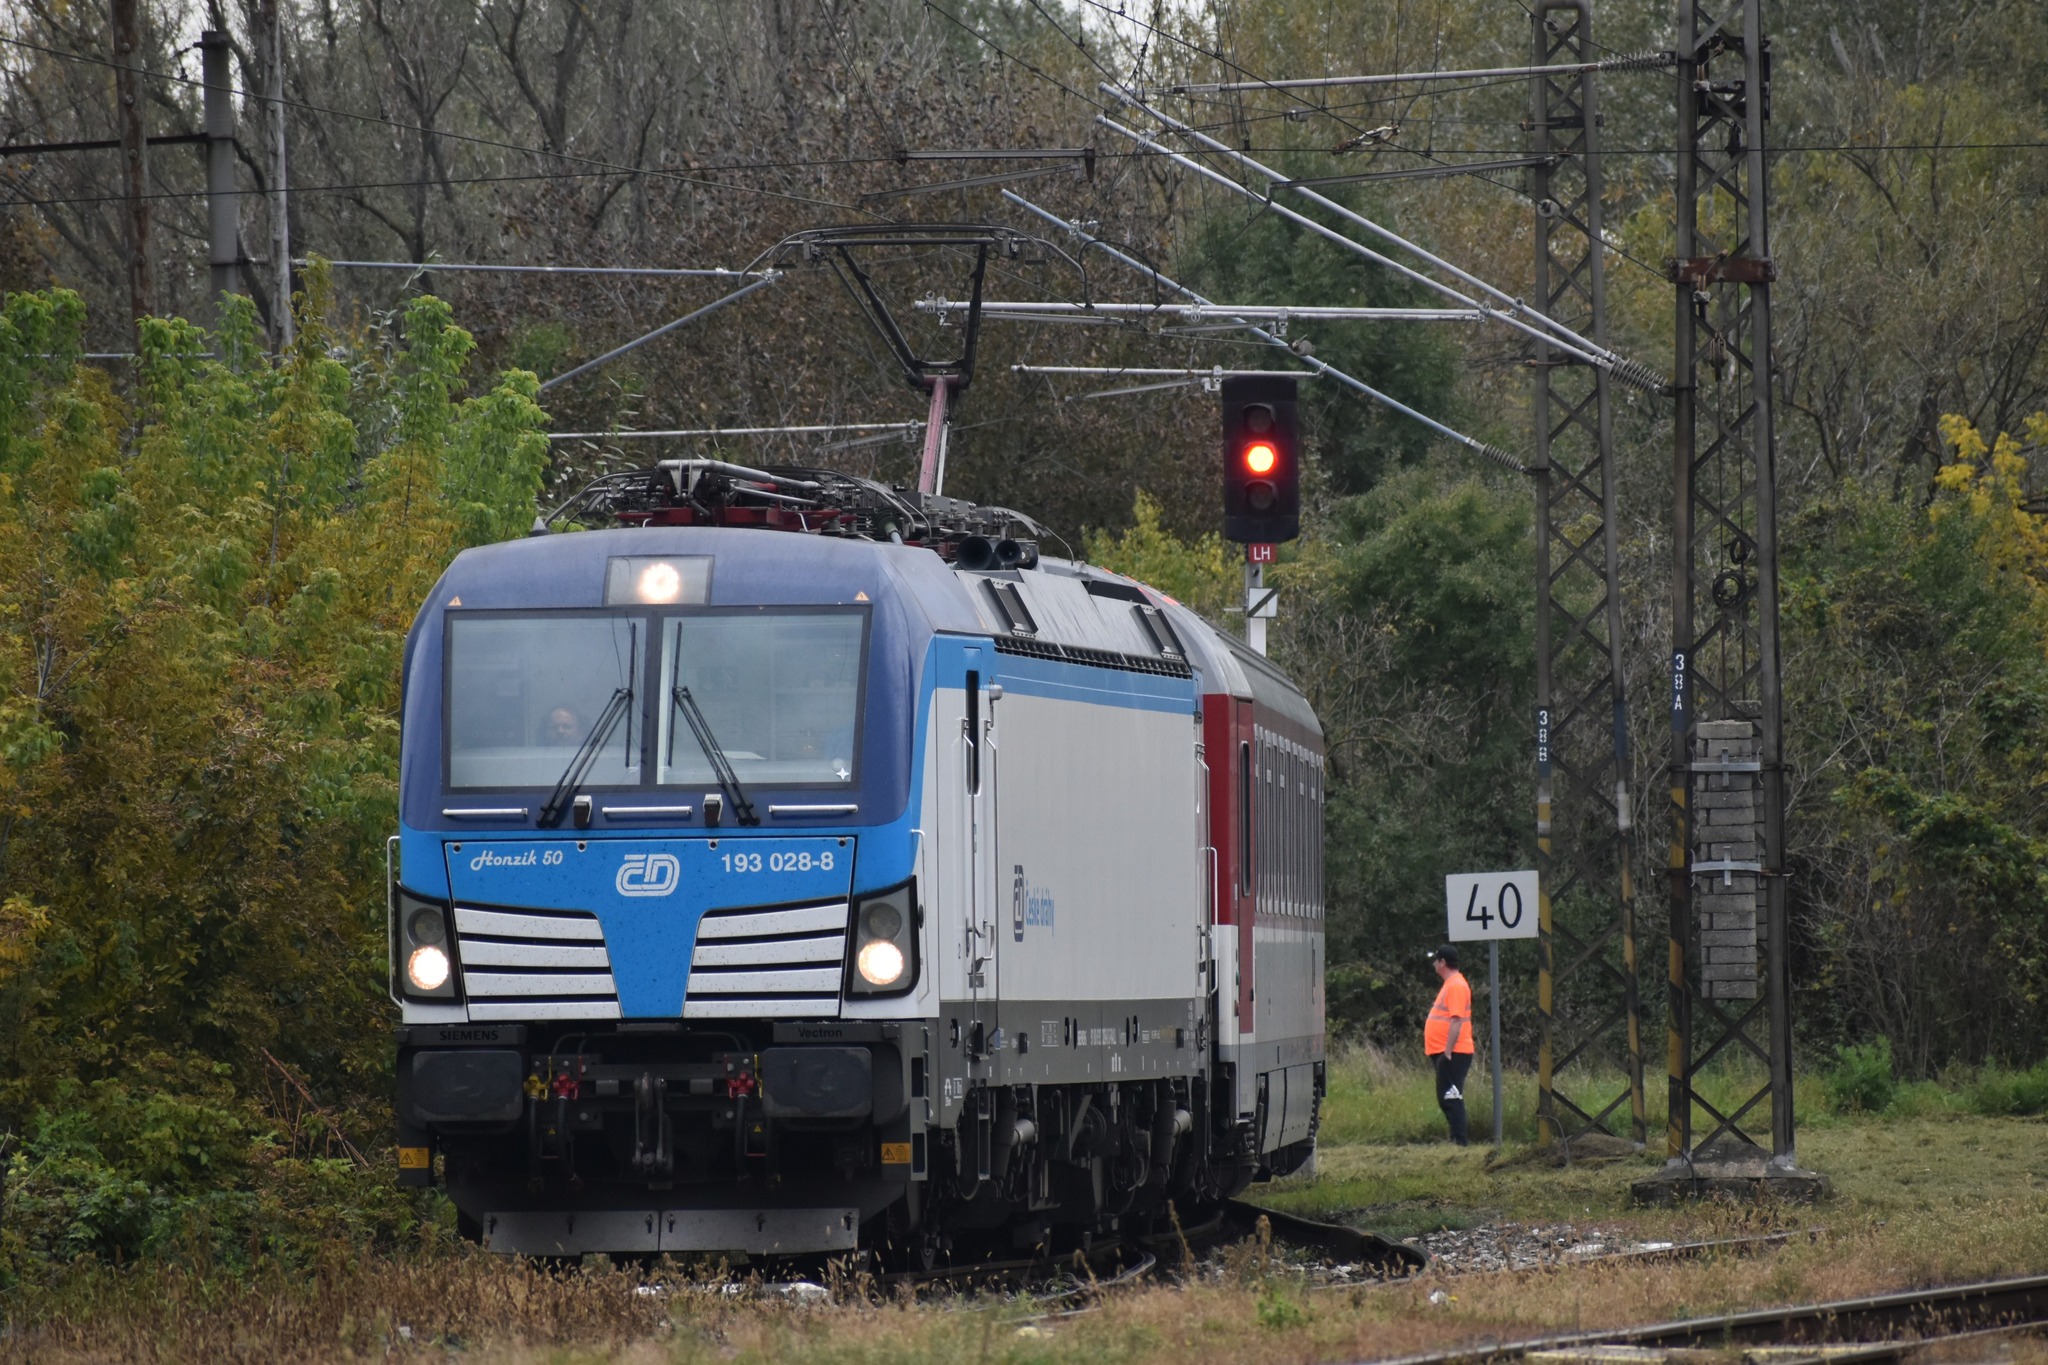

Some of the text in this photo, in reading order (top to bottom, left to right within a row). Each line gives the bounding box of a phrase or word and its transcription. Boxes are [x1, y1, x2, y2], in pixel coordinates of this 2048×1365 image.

[1253, 546, 1271, 561] LH
[470, 849, 564, 871] Honzik 50
[721, 851, 835, 873] 193 028-8
[1466, 882, 1523, 930] 40
[440, 1030, 499, 1041] SIEMENS
[798, 1027, 843, 1038] Vectron
